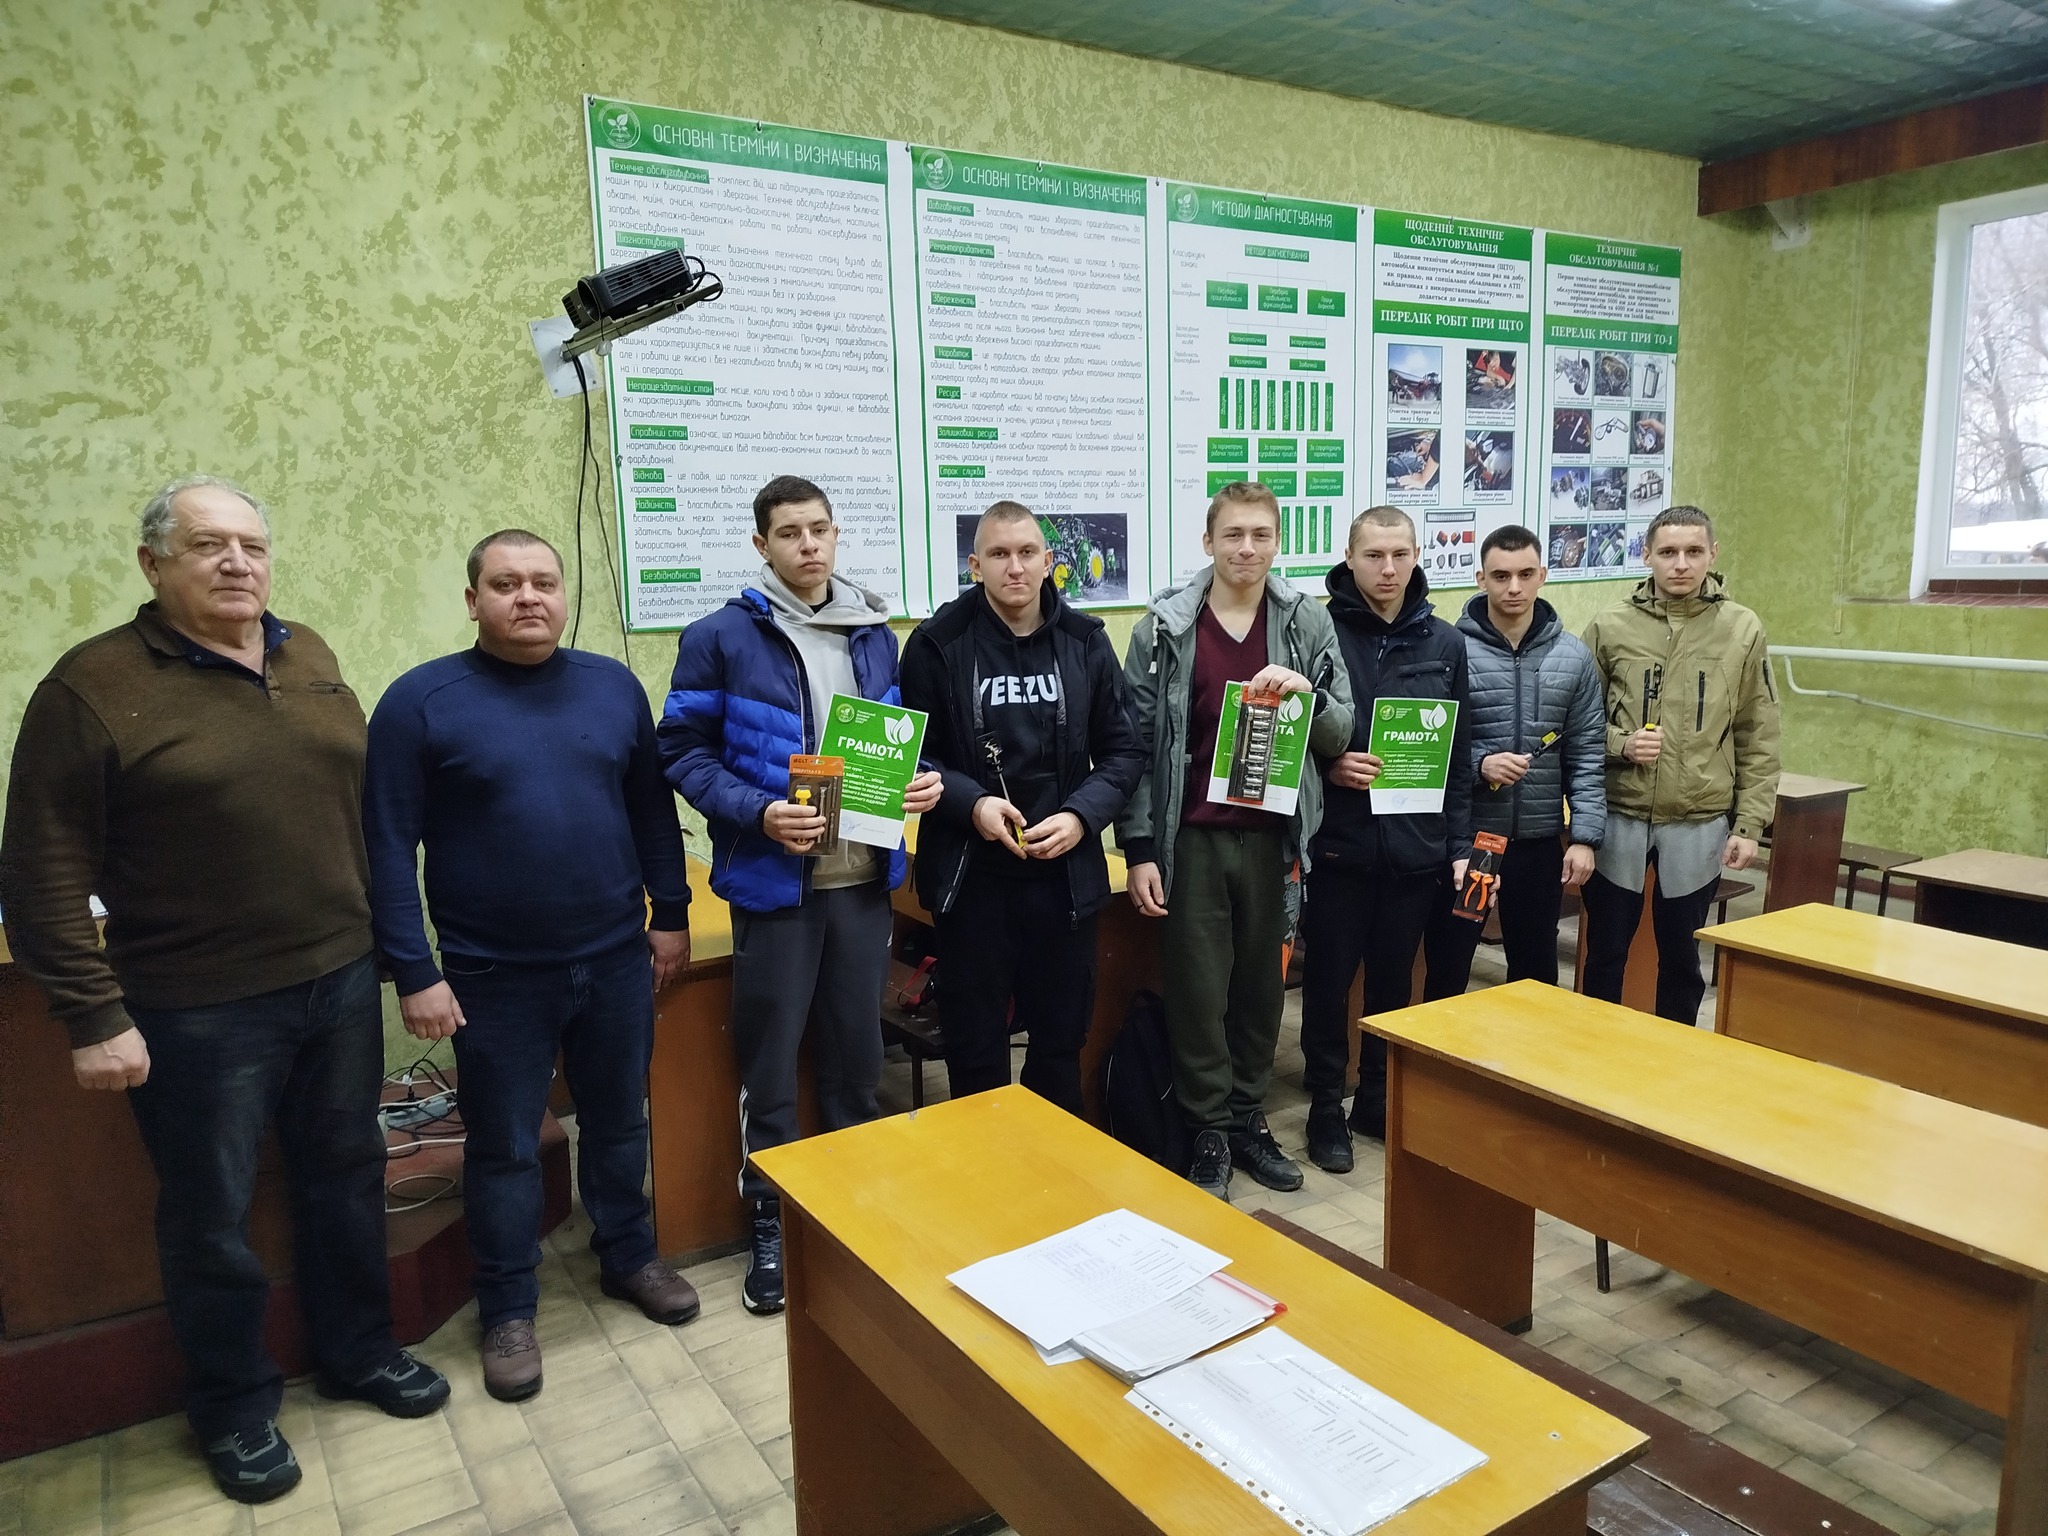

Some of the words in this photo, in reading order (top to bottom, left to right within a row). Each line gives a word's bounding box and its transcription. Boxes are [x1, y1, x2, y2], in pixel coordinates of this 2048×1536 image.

[654, 124, 714, 150] ОСНОВНІ
[721, 132, 780, 156] ТЕРМІНИ
[785, 143, 789, 158] І
[794, 142, 881, 171] ВИЗНАЧЕННЯ
[610, 160, 644, 173] Технічне
[645, 164, 706, 182] обслуговування
[717, 176, 750, 187] комплекс
[779, 182, 824, 196] підтримують
[826, 189, 879, 202] працездатність
[963, 166, 1010, 188] ОСНОВНІ
[1015, 173, 1062, 195] ТЕРМІНИ
[1066, 182, 1069, 196] І
[1073, 181, 1141, 205] ВИЗНАЧЕННЯ
[1212, 200, 1250, 218] МЕТОДИ
[1254, 205, 1333, 228] ДІАГНОСТУВАННЯ
[608, 219, 678, 233] розконсервування
[1405, 219, 1454, 234] ЩОДЕННЕ
[1458, 226, 1504, 241] ТЕХНІЧНЕ
[616, 232, 678, 250] Діагностування
[1410, 234, 1499, 254] ОБСЛУГОВУВАННЯ
[1596, 244, 1637, 257] ТЕХНІЧНЕ
[1569, 254, 1645, 270] ОБСЛУГОВУВАННЯ
[1648, 264, 1659, 272] №1
[1381, 310, 1432, 324] ПЕРЕЛІК
[1436, 314, 1468, 327] РОБІТ
[1472, 318, 1495, 329] ПРИ
[1498, 320, 1524, 332] ЩТО
[1551, 326, 1596, 339] ПЕРЕЛІК
[1600, 329, 1628, 340] РОБІТ
[1630, 332, 1651, 343] ПРИ
[1654, 334, 1673, 345] ТО-1
[627, 379, 691, 393] Непрацездатний
[693, 383, 712, 393] стан
[938, 387, 959, 397] Ресурс
[630, 426, 666, 438] Справний
[667, 427, 686, 437] стан
[937, 427, 974, 436] Залишковий
[977, 428, 996, 438] ресурс
[633, 469, 662, 479] Відмова
[939, 466, 958, 476] Строк
[962, 466, 983, 476] служби
[629, 486, 674, 494] характером
[676, 484, 718, 493] виникнення
[721, 484, 747, 494] відмови
[635, 499, 674, 509] Надійність
[687, 500, 733, 509] властивість
[632, 513, 685, 524] встановлених
[634, 526, 672, 536] здатність
[677, 526, 720, 537] виконувати
[643, 569, 699, 580] Безвідмовність
[637, 584, 696, 595] працездатність
[699, 584, 734, 593] протягом
[638, 596, 694, 607] Безвідмовність
[639, 610, 685, 620] відношенням
[1384, 731, 1439, 742] ГРАМОТА
[838, 736, 903, 760] ГРАМОТА
